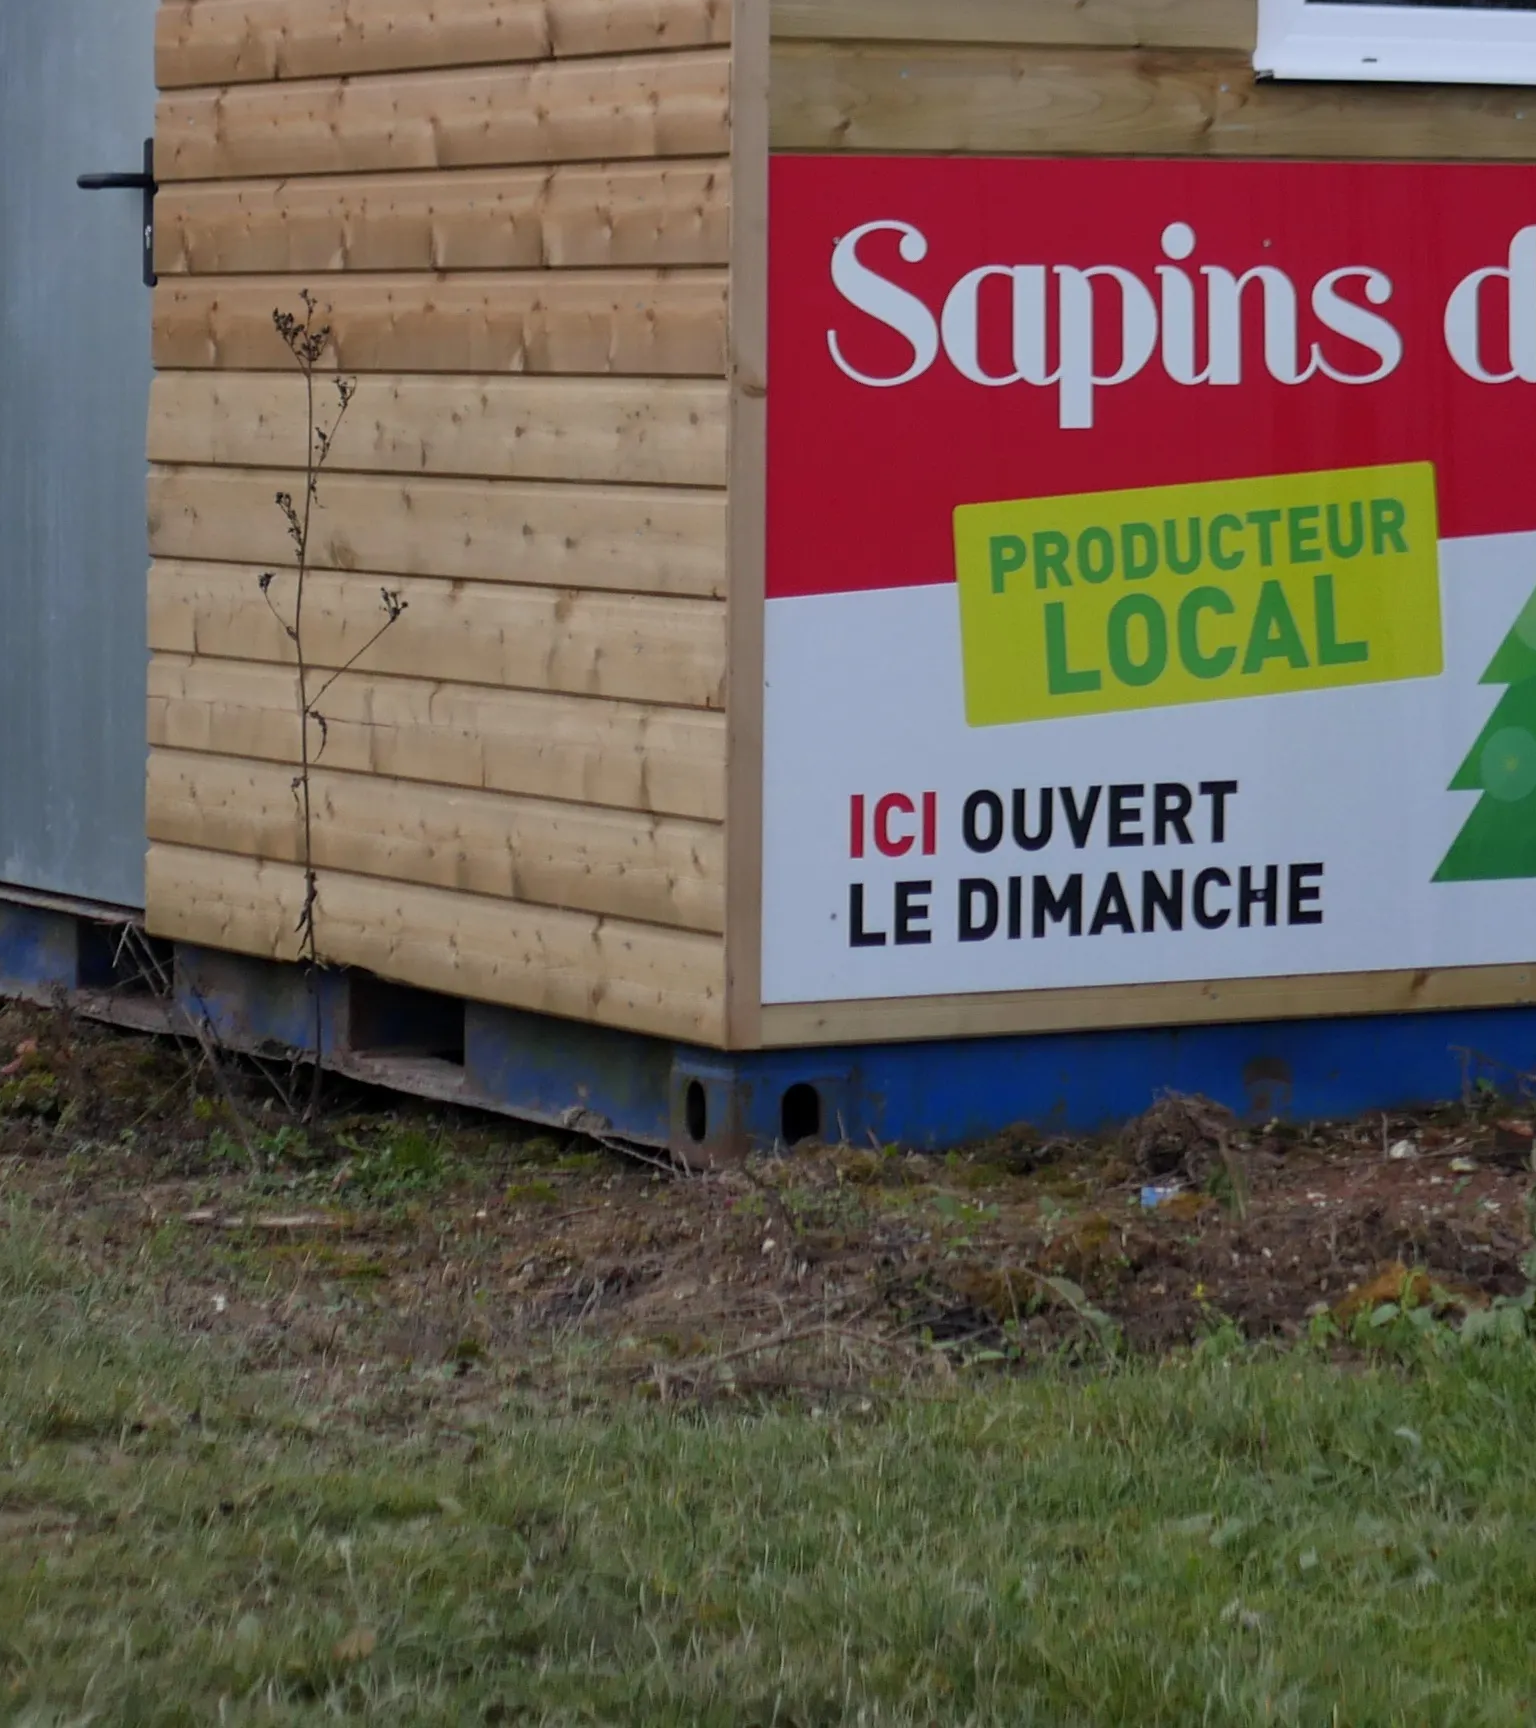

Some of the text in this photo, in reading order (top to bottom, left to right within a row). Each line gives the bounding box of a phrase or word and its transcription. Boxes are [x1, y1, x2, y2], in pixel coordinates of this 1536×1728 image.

[828, 220, 1402, 428] Sapins
[990, 498, 1408, 594] PRODUCTEUR
[1044, 575, 1368, 695] LOCAL
[849, 780, 1238, 858] ICI OUVERT
[848, 863, 1324, 947] LE DIMANCHE
